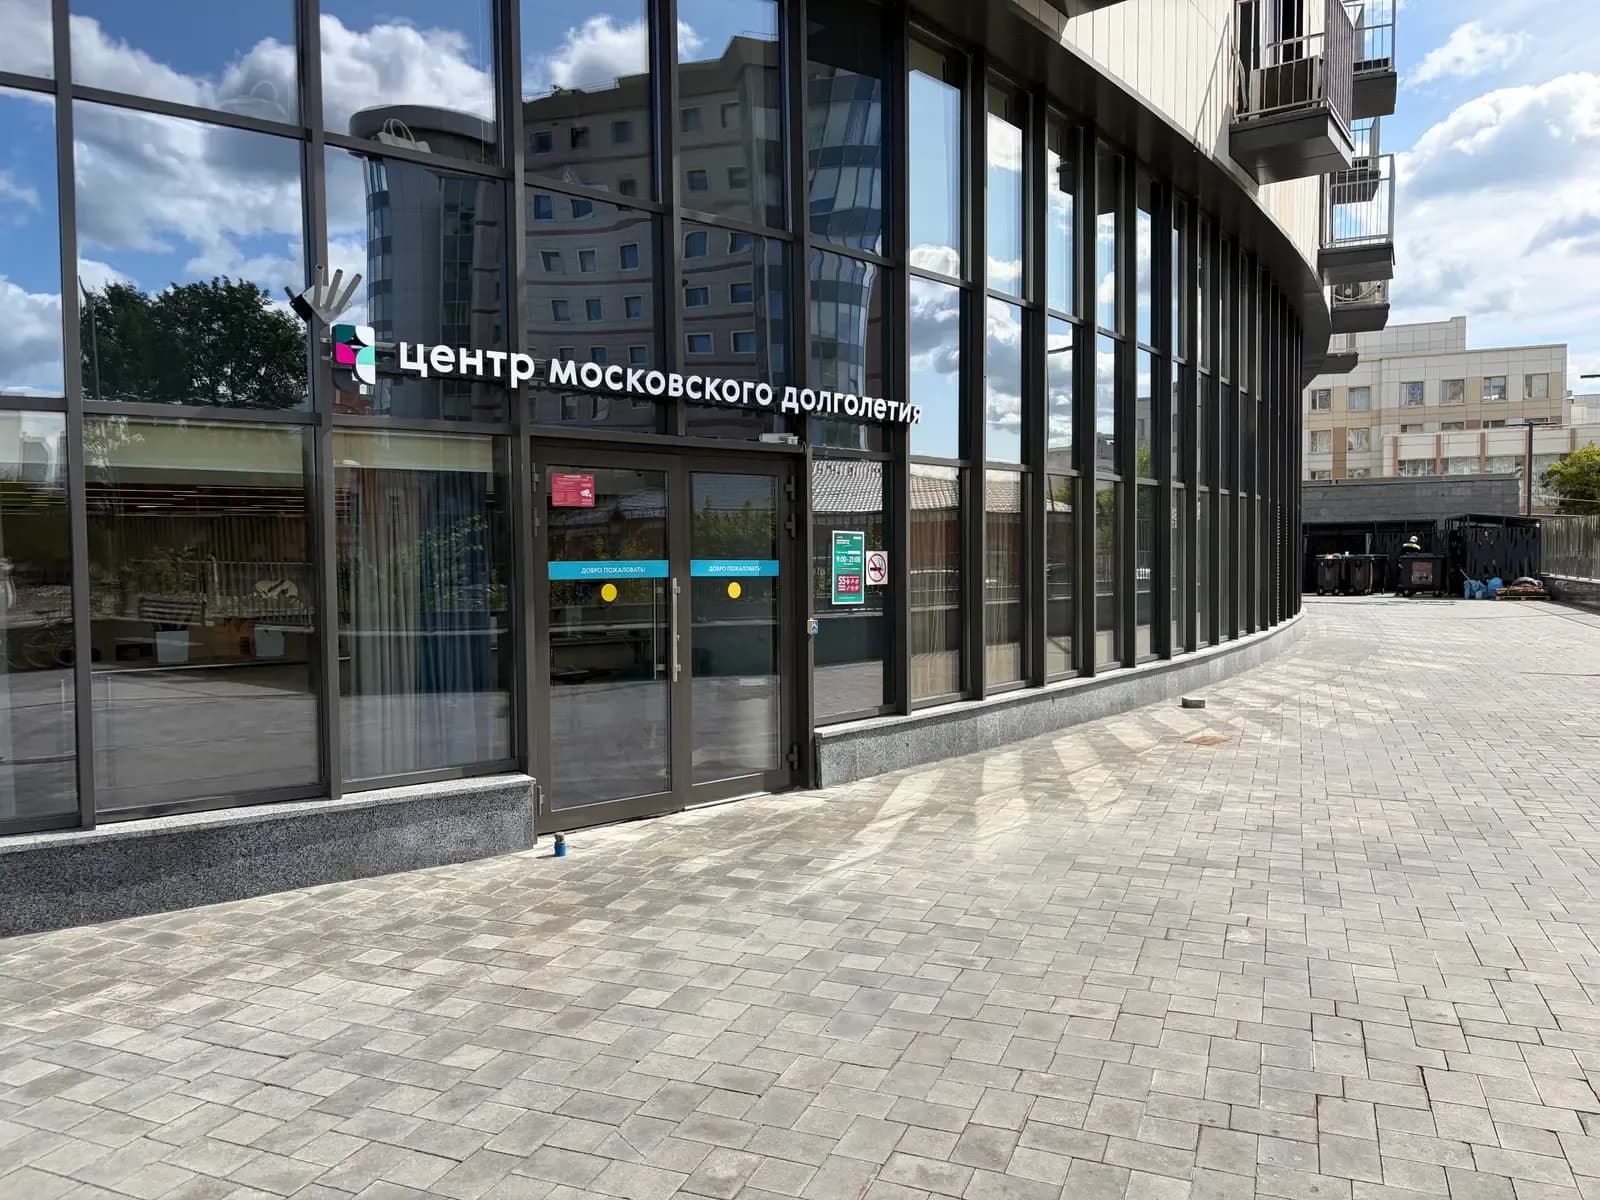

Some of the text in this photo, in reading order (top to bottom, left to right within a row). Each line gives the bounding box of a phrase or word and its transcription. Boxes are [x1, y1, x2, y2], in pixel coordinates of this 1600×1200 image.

[399, 341, 924, 425] центр московского долголетия
[581, 567, 603, 575] ДОБРО
